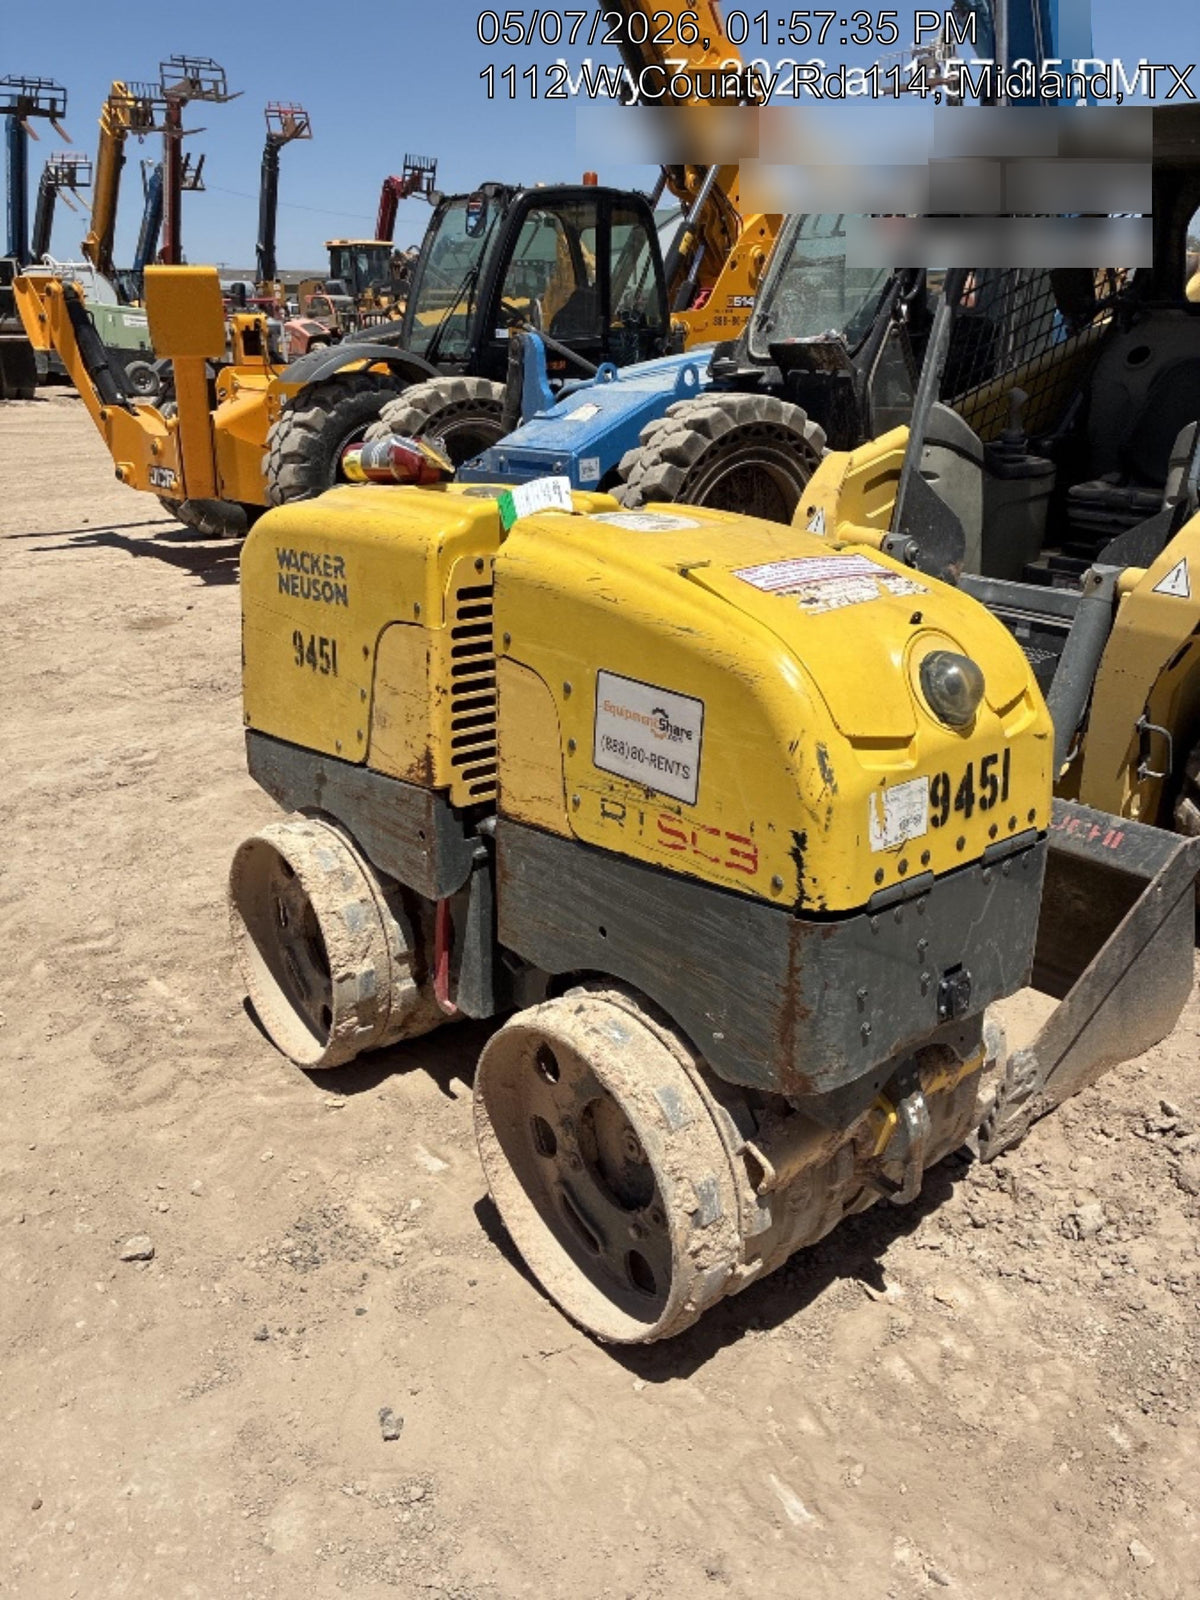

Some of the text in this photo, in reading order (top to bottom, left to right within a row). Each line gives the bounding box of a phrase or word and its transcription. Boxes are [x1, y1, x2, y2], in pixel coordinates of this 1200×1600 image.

[276, 547, 347, 580] WACKER
[277, 572, 349, 608] NEUSON
[292, 629, 338, 678] 9451
[603, 700, 692, 740] EquipmentShare
[601, 734, 691, 780] (888)80-RENTS
[930, 748, 1010, 828] 9451
